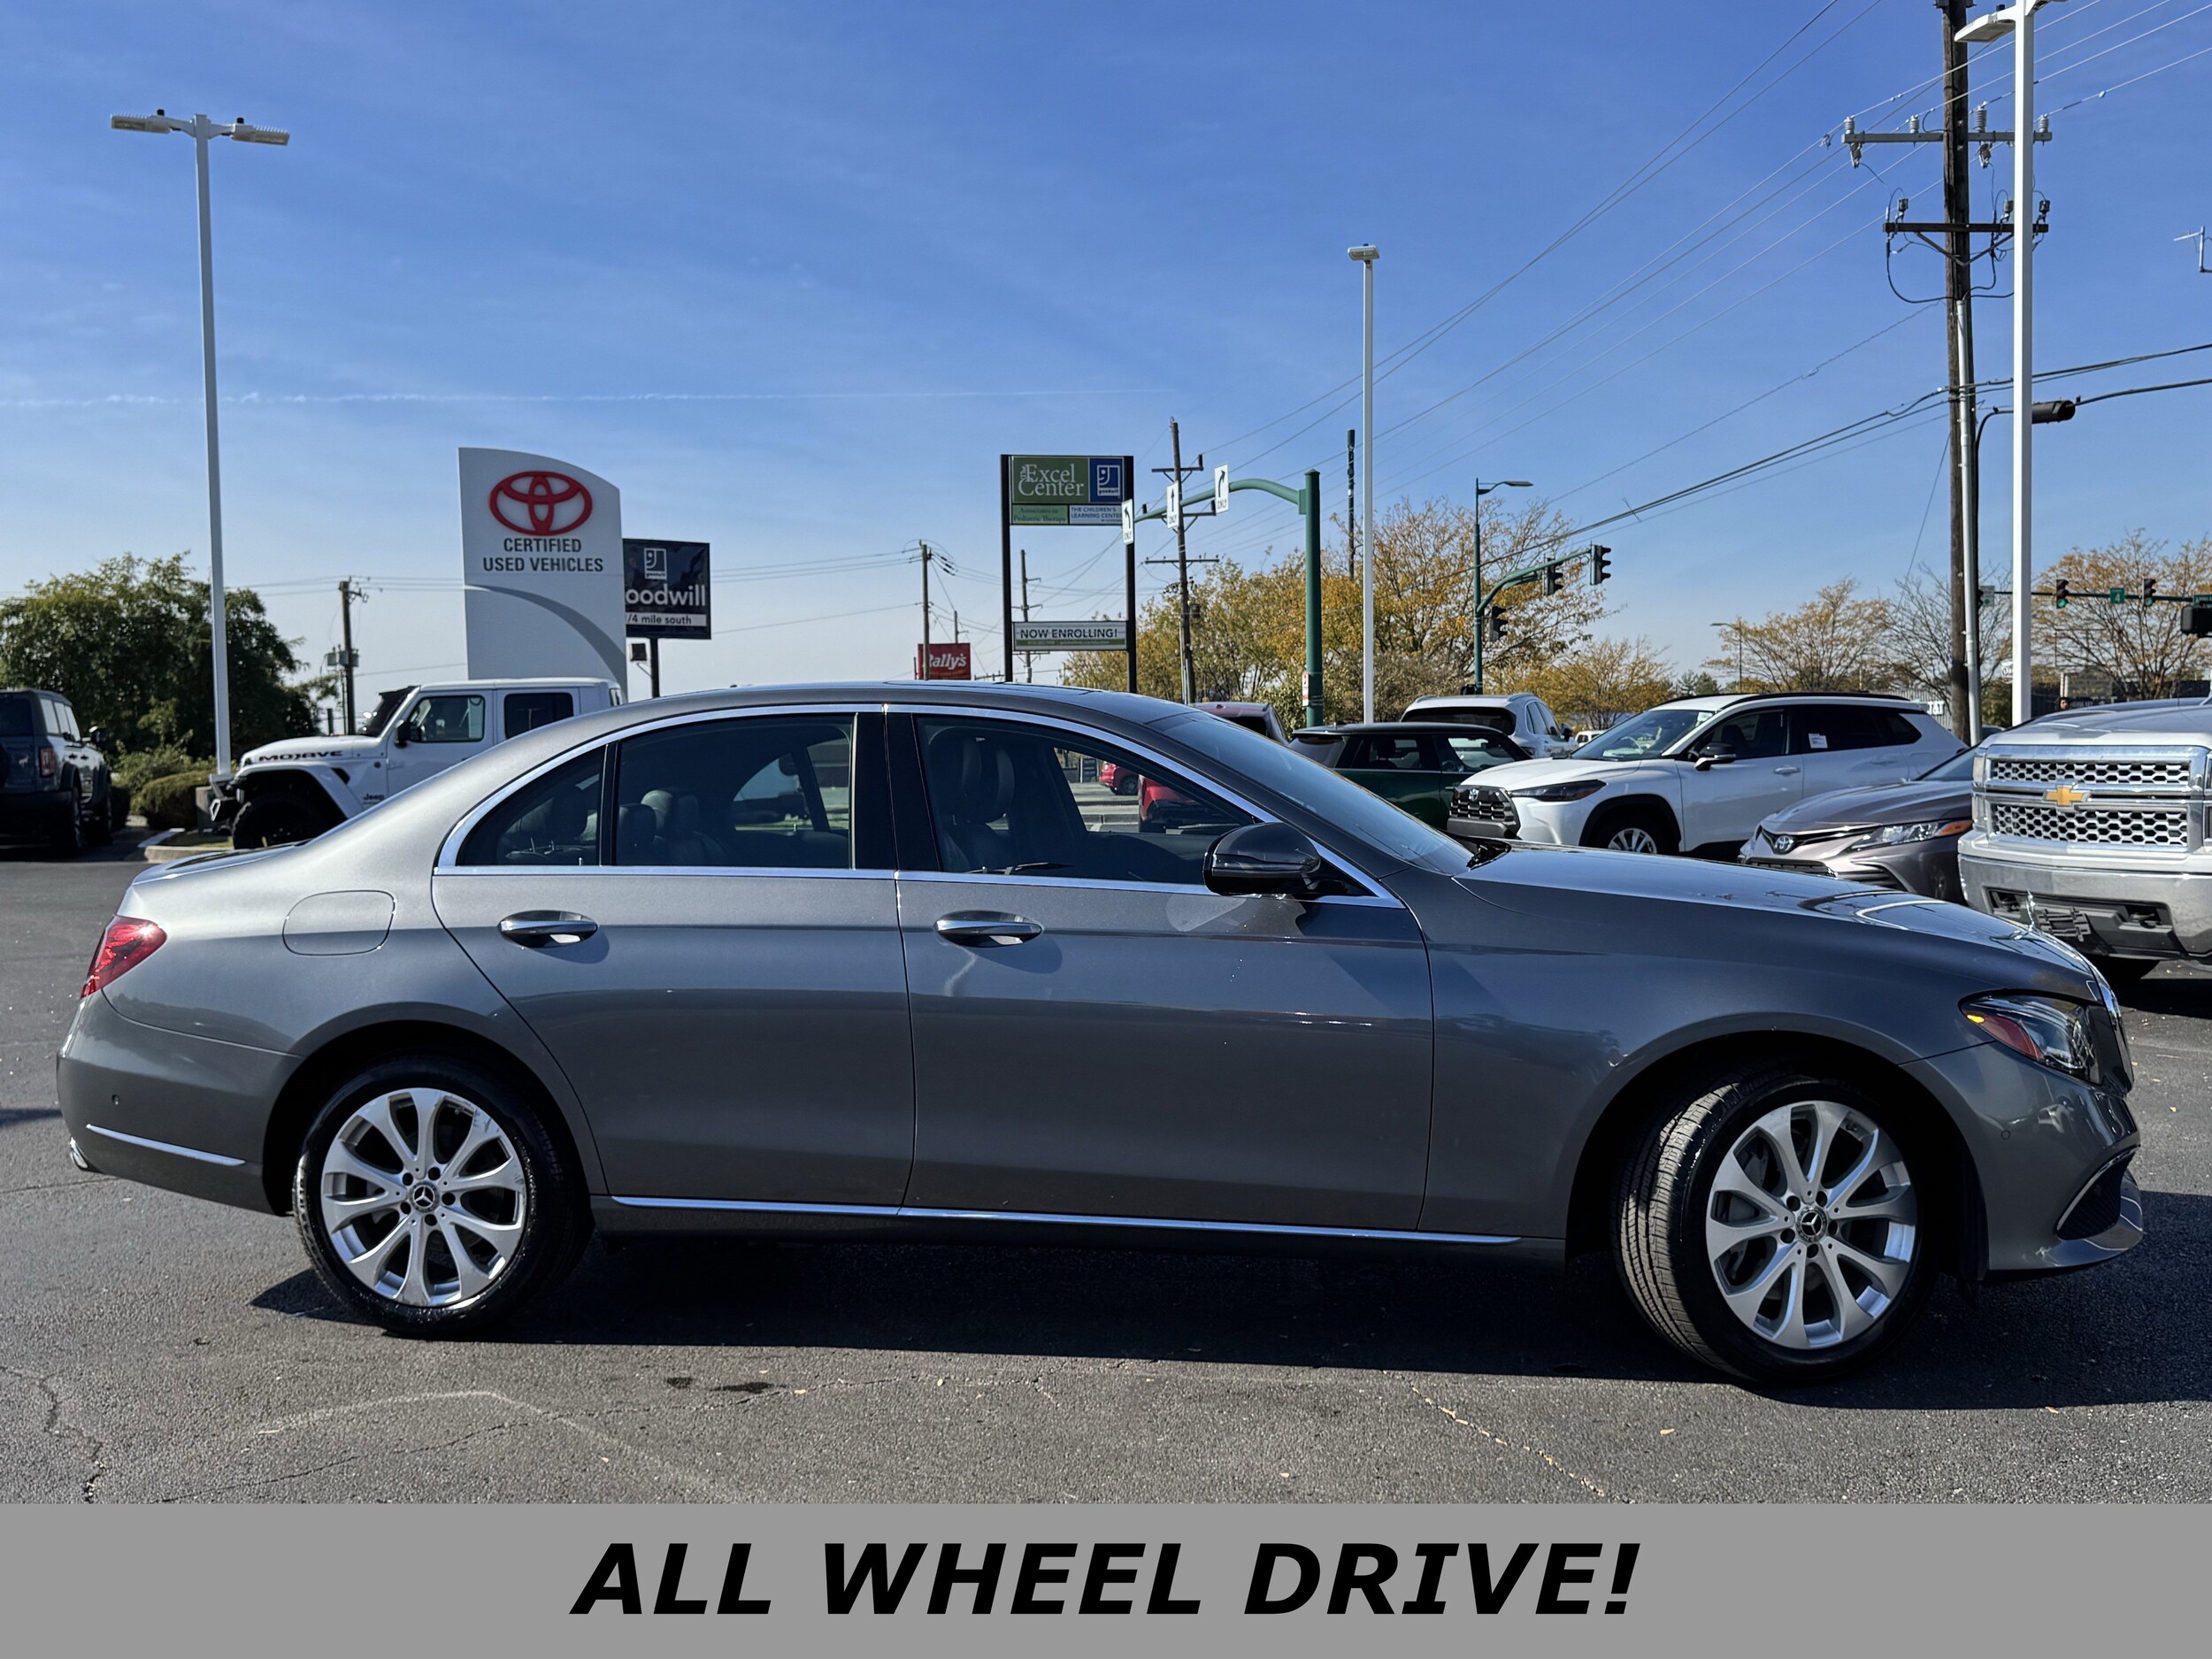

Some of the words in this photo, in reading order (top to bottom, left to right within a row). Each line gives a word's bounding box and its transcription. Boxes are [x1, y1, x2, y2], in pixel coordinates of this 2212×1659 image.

[1025, 464, 1076, 482] Excel
[1018, 478, 1085, 495] Center
[503, 538, 582, 552] CERTIFIED
[483, 557, 525, 572] USED
[529, 557, 603, 572] VEHICLES
[626, 583, 705, 606] oodwill
[664, 616, 692, 625] south
[1020, 629, 1048, 638] NOW
[1052, 628, 1118, 638] ENROLLING!
